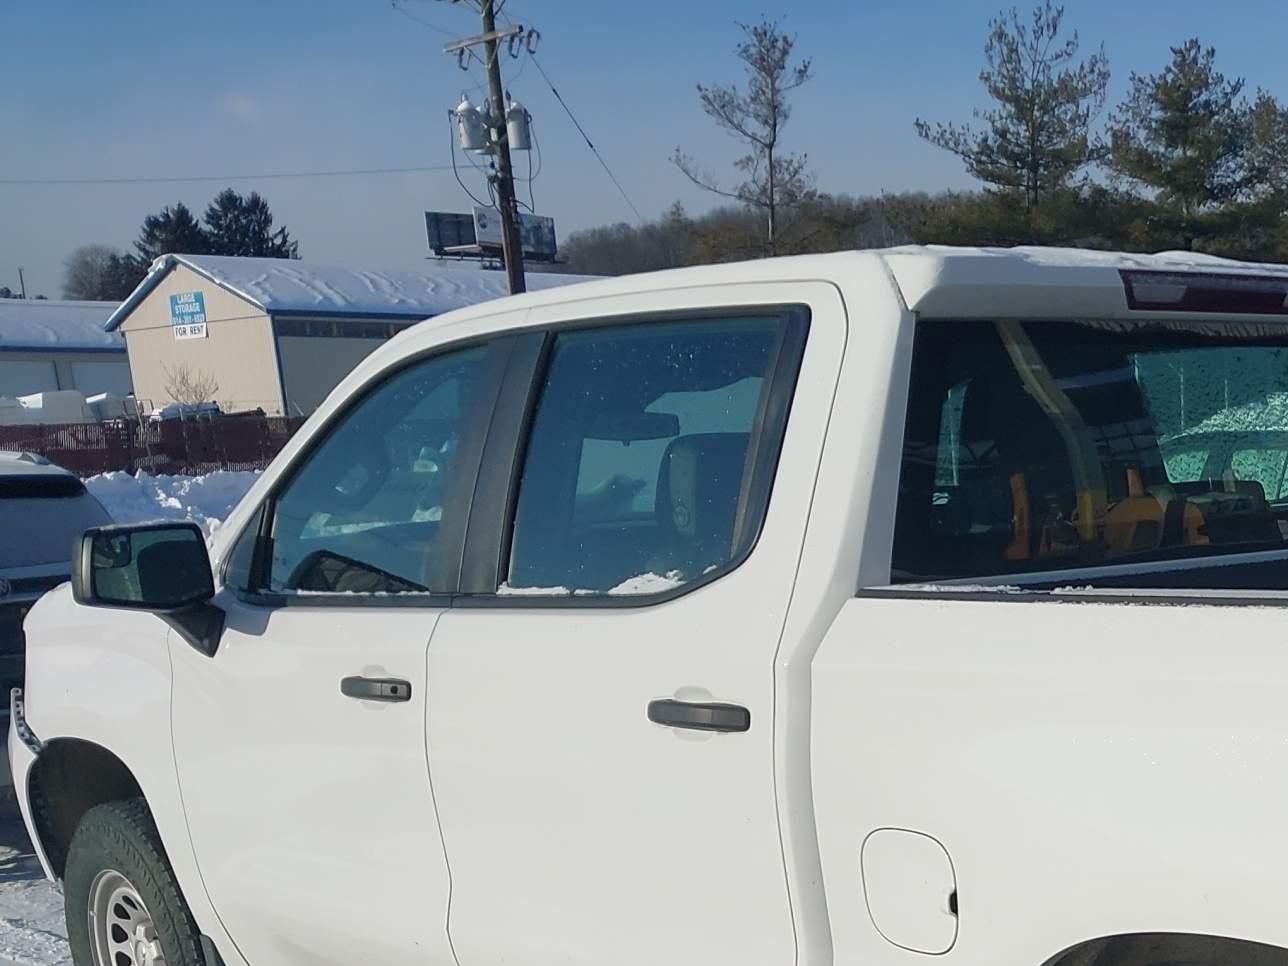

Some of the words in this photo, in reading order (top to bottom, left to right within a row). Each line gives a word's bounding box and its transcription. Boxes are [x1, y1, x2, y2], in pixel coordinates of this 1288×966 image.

[175, 302, 201, 314] STORAGE
[175, 326, 187, 337] FOR
[190, 324, 205, 336] RENT
